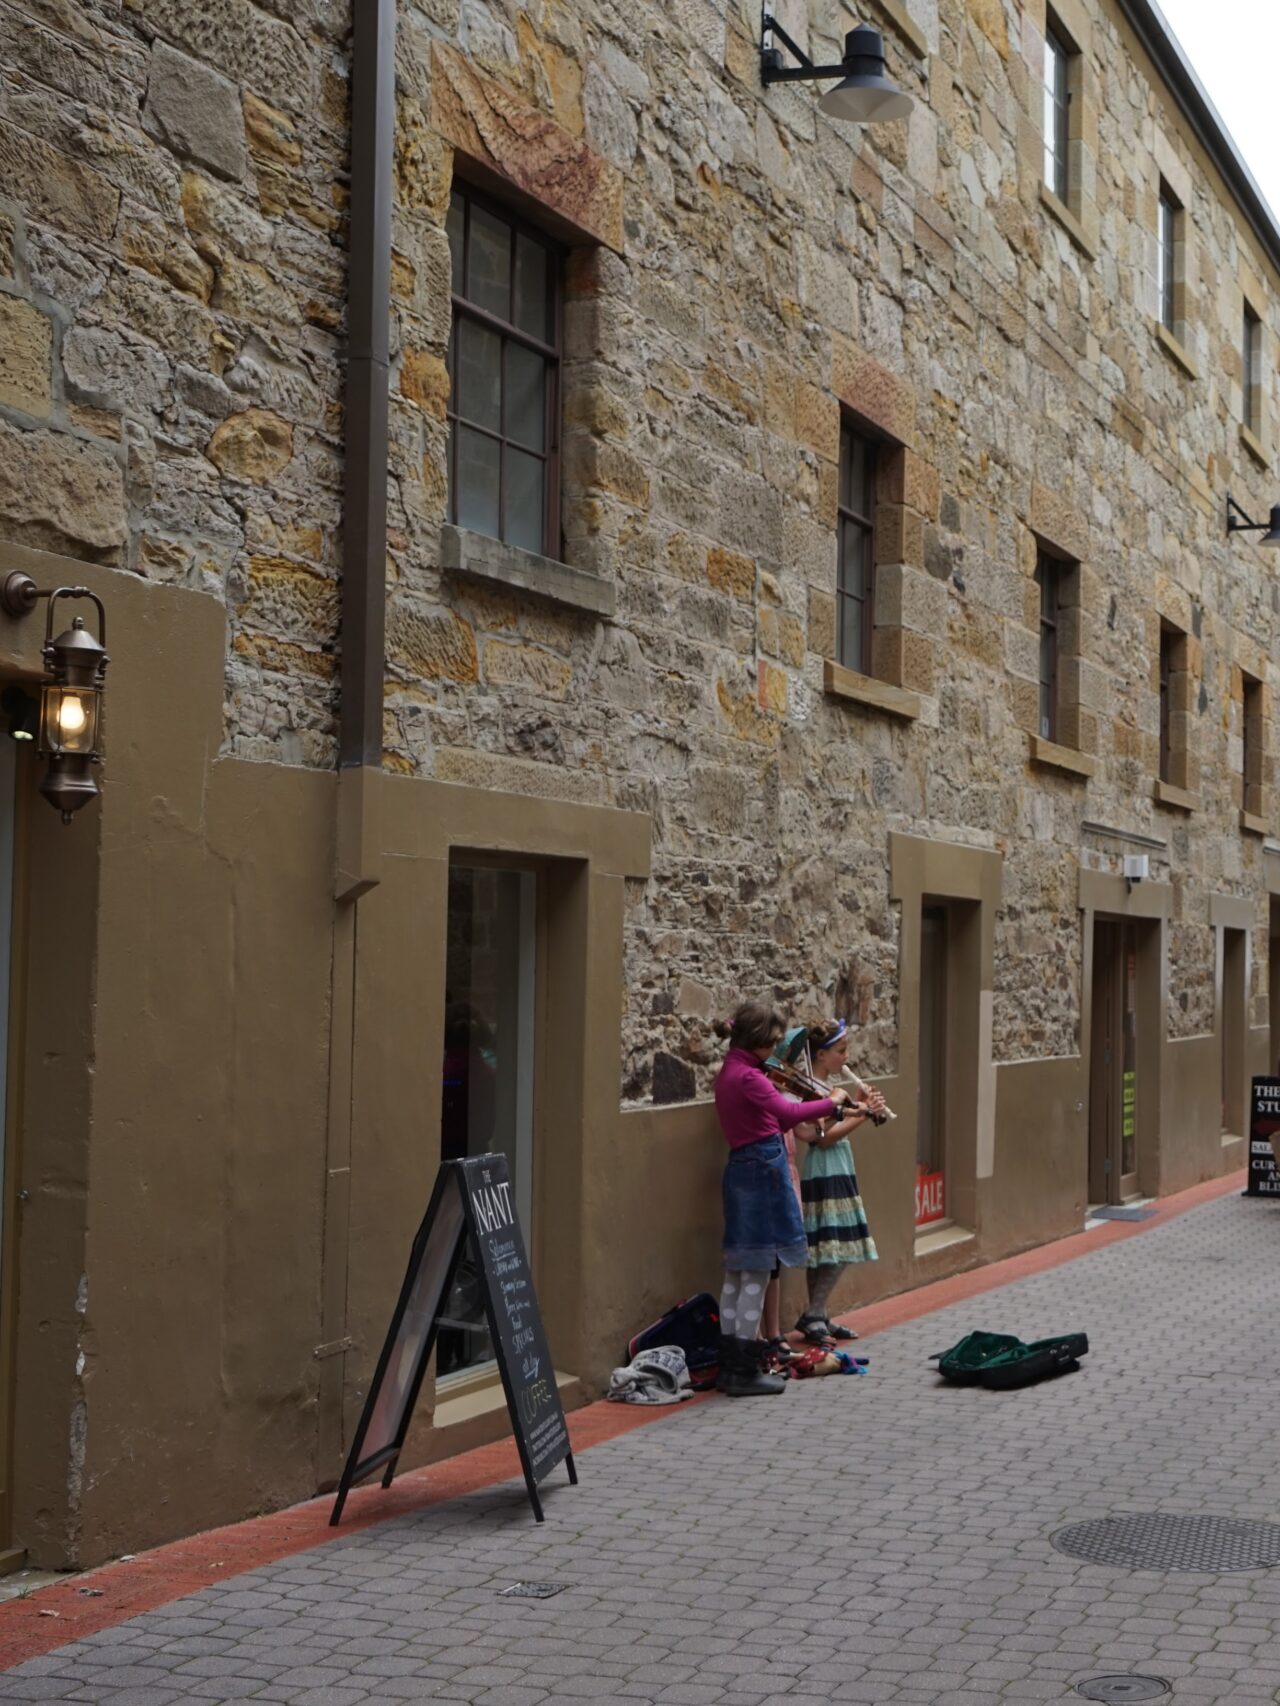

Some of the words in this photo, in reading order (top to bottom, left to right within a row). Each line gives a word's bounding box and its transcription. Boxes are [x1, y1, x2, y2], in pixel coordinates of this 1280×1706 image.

[1254, 1085, 1280, 1098] THE
[482, 1169, 492, 1184] THE
[1252, 1160, 1279, 1171] CUR
[472, 1182, 514, 1236] NANT
[914, 1180, 943, 1218] SALE
[521, 1379, 553, 1425] COFFEE
